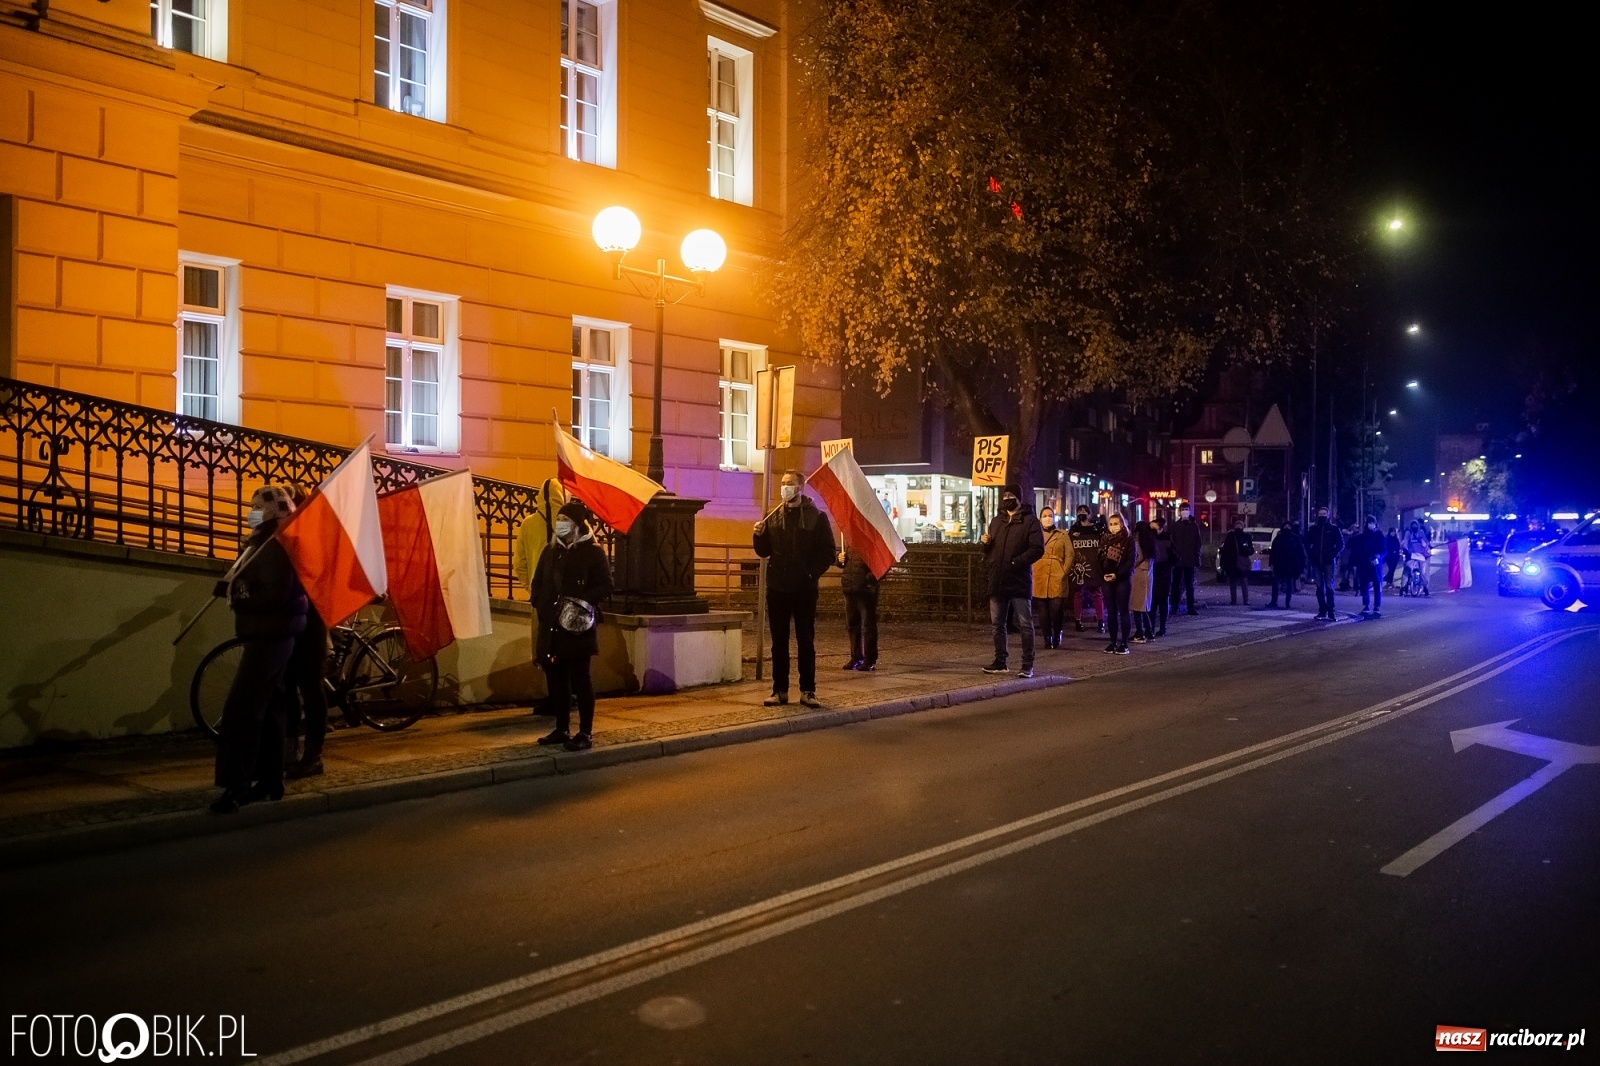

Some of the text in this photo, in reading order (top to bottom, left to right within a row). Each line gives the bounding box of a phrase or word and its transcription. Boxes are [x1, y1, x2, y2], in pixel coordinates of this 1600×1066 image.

[977, 437, 1002, 456] PIS
[975, 457, 1006, 475] OFF!
[1242, 478, 1255, 495] P
